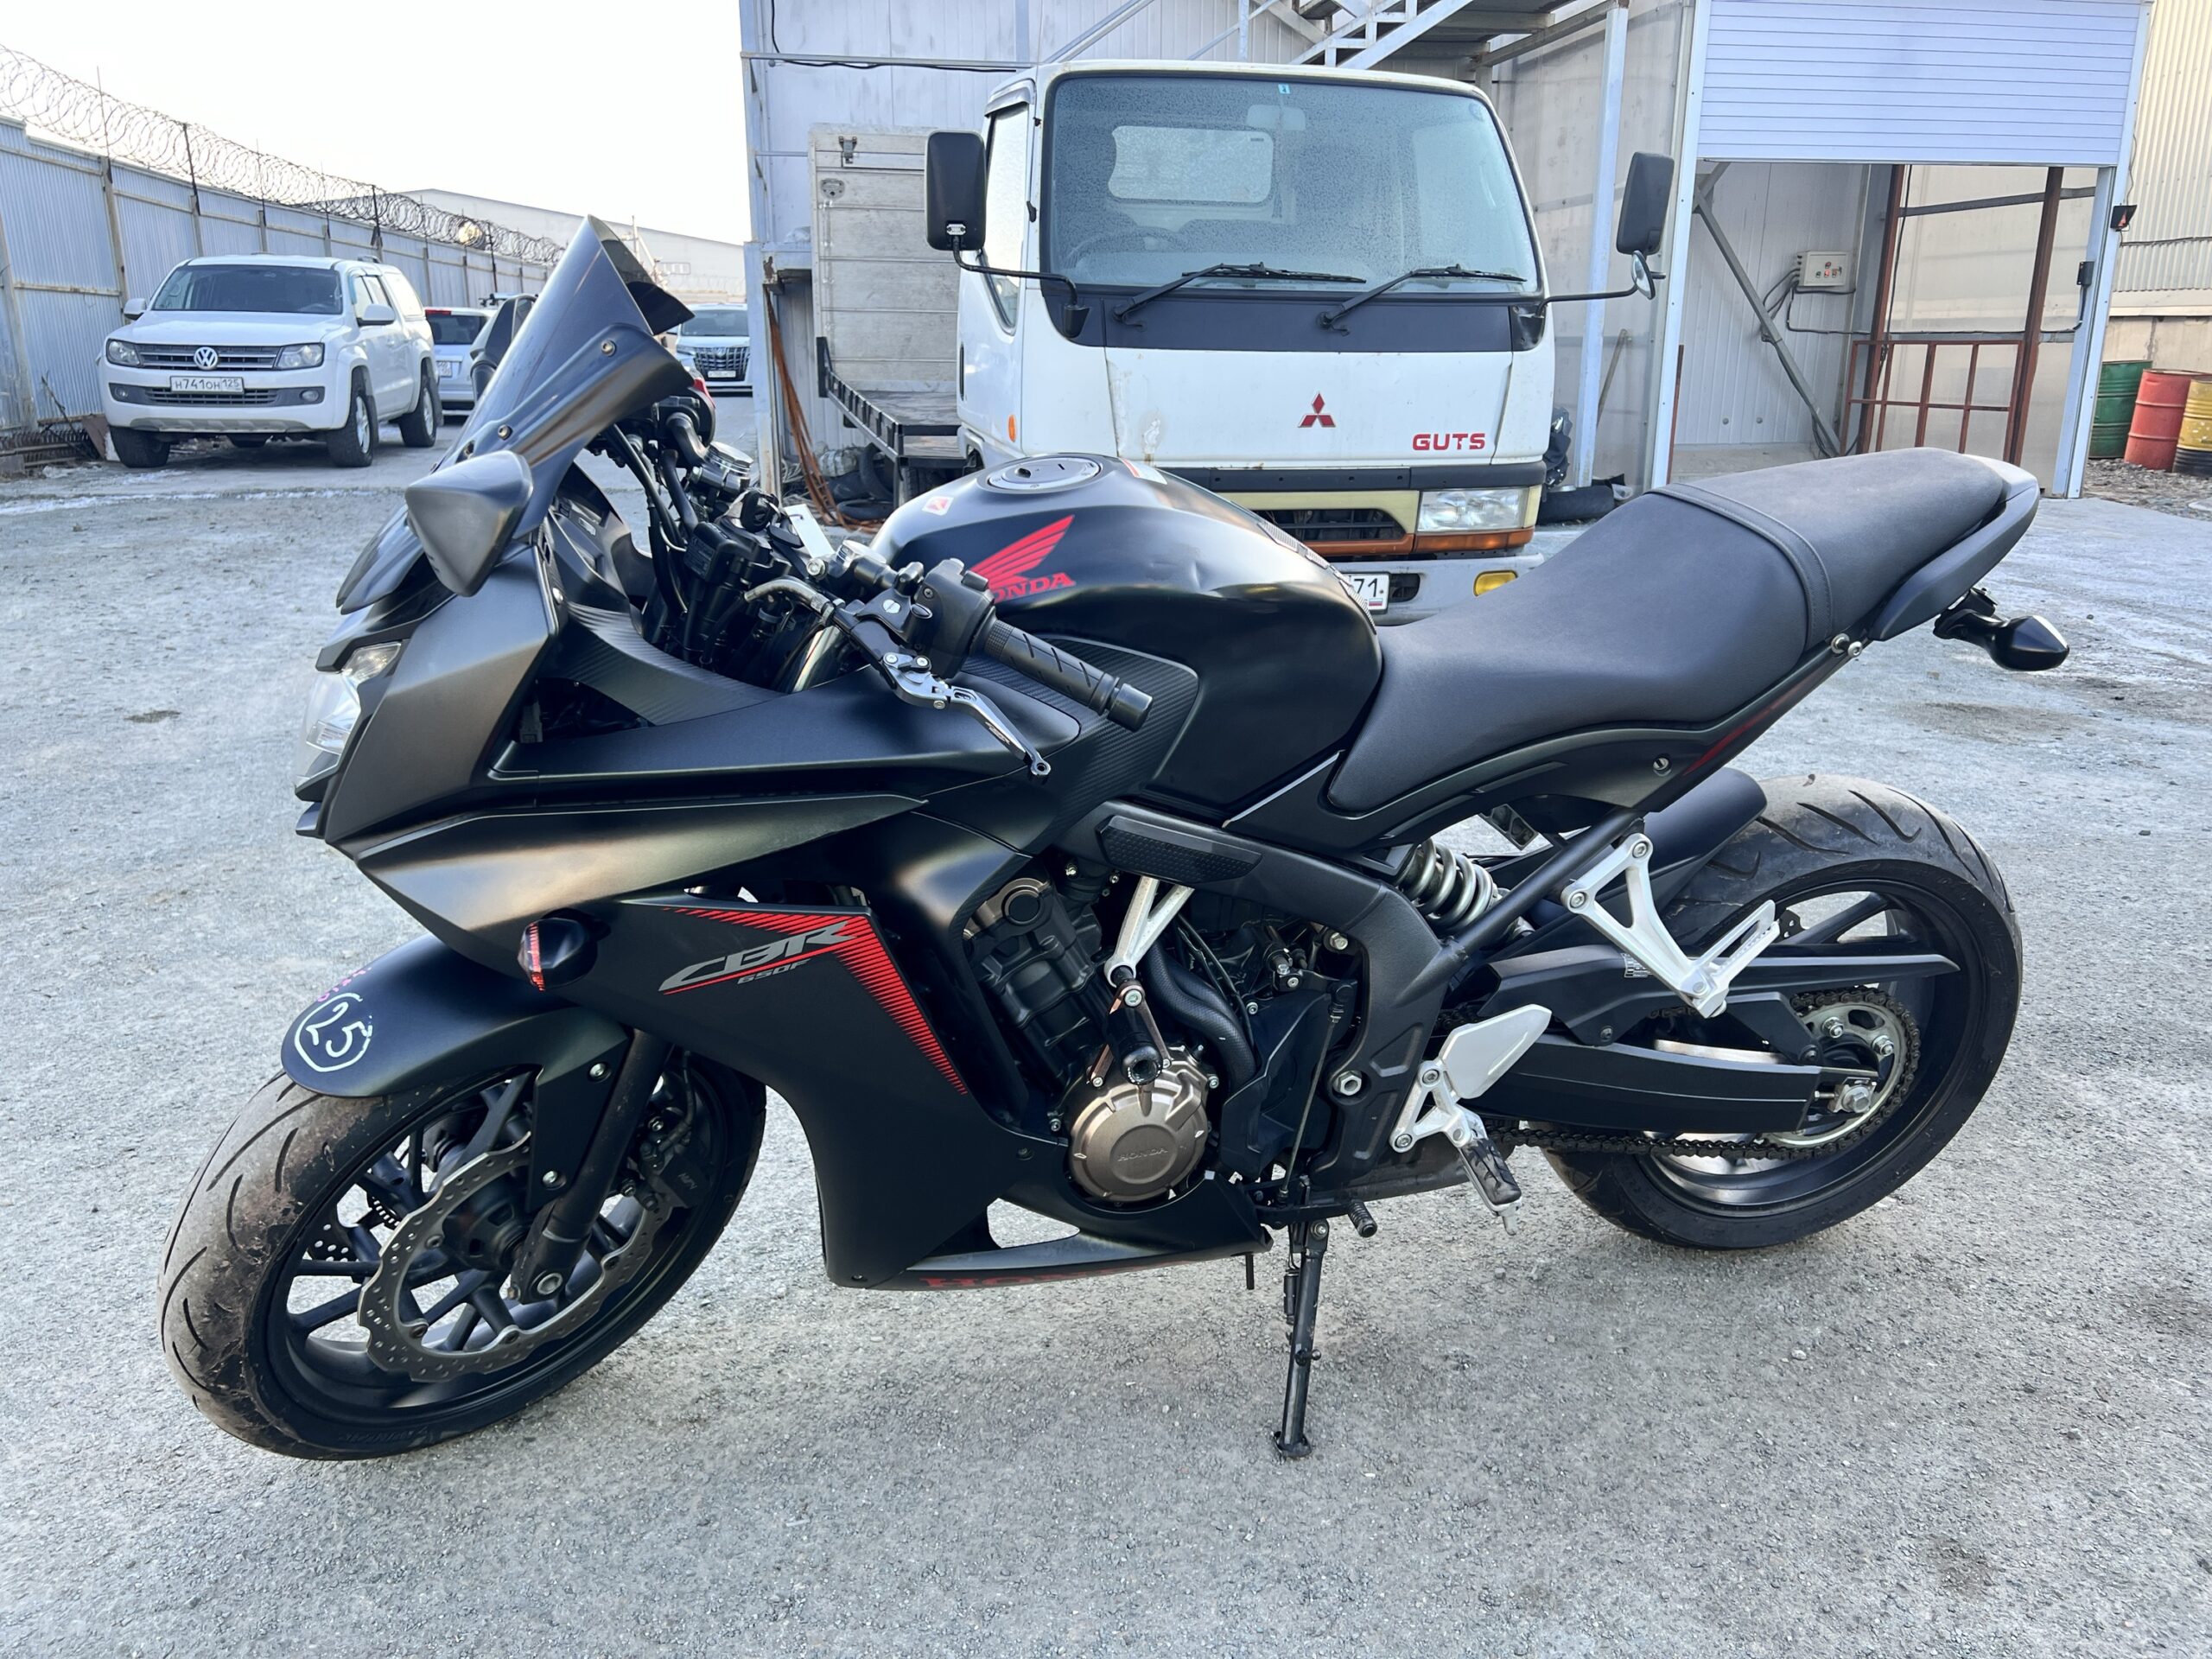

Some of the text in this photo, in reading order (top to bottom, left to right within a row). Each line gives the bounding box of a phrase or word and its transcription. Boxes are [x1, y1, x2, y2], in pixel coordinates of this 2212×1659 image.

[194, 346, 218, 370] VW
[222, 378, 239, 388] 125
[1412, 433, 1485, 450] GUTS
[994, 572, 1076, 604] ONDA
[1354, 578, 1377, 597] 71
[658, 920, 857, 992] CBR
[737, 957, 812, 985] 650F
[305, 1001, 368, 1058] 25
